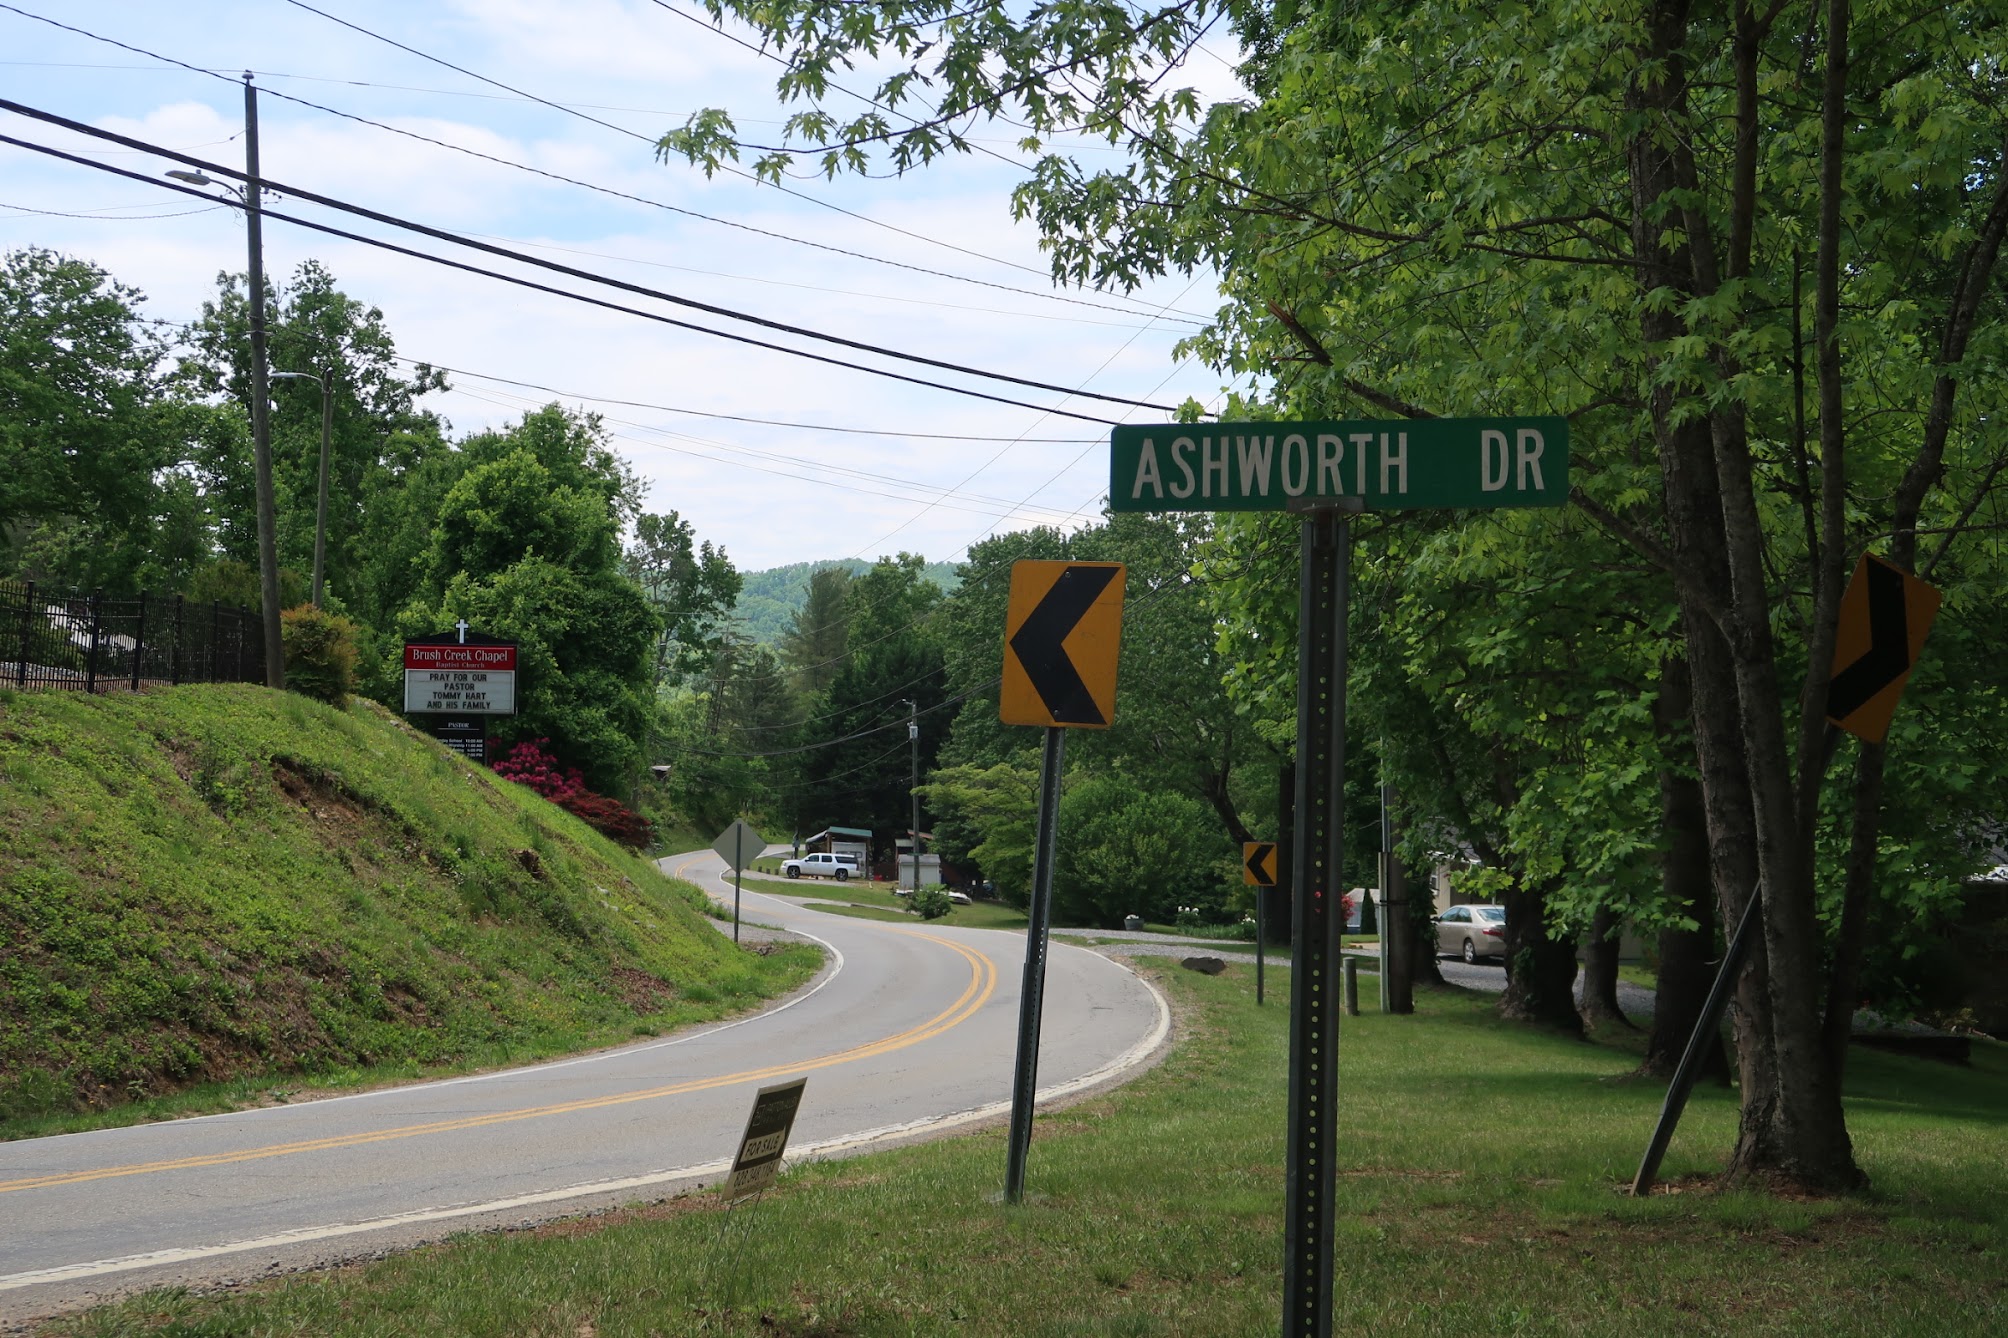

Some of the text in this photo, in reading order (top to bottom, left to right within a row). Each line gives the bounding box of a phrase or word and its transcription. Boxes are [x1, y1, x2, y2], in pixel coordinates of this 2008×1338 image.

[1131, 429, 1545, 500] ASHWORTH DR
[413, 649, 508, 663] Brush Creek Chapel
[429, 673, 487, 682] PRAY FOR OUR
[444, 683, 475, 691] PASTOR
[433, 692, 487, 700] TOMMY HART
[426, 701, 491, 709] AND HIS FAMILY
[745, 1135, 780, 1157] FOR SALE
